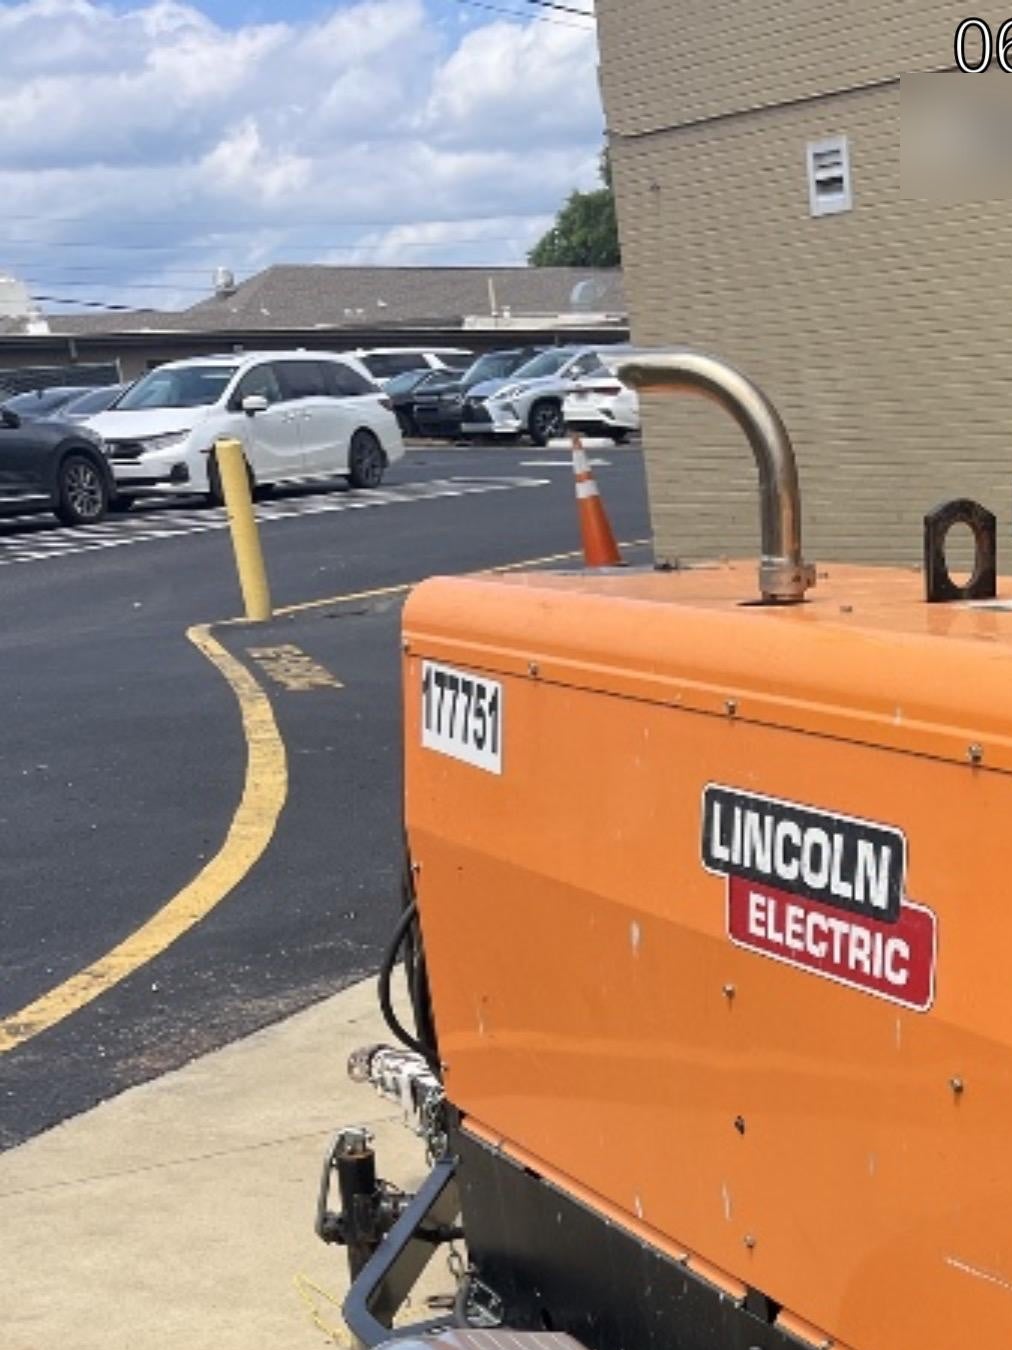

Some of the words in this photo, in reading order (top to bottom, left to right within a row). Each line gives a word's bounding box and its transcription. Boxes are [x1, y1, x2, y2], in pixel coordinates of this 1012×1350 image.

[422, 665, 498, 755] 177751
[711, 800, 893, 911] LINCOLN
[748, 891, 911, 986] ELECTRIC
